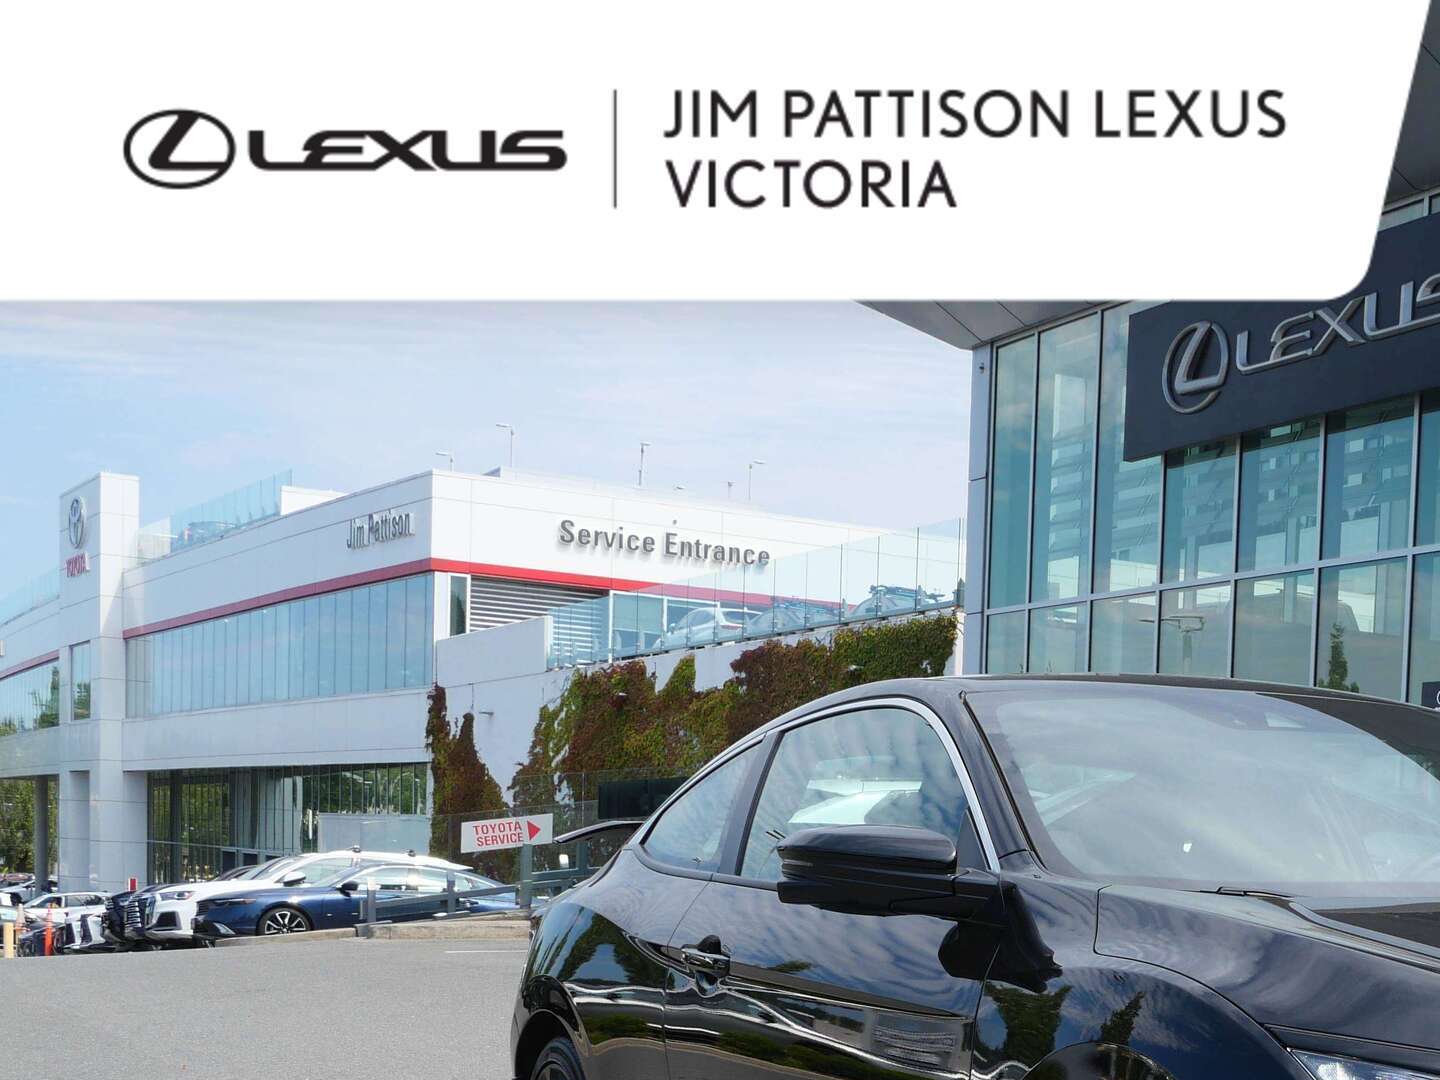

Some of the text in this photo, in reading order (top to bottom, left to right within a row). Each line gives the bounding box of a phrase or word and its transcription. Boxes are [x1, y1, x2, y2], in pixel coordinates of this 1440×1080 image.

[346, 508, 412, 550] Jim Pattison
[560, 519, 770, 567] Service Entrance
[472, 821, 522, 835] TOYOTA
[476, 832, 524, 847] SERVICE
